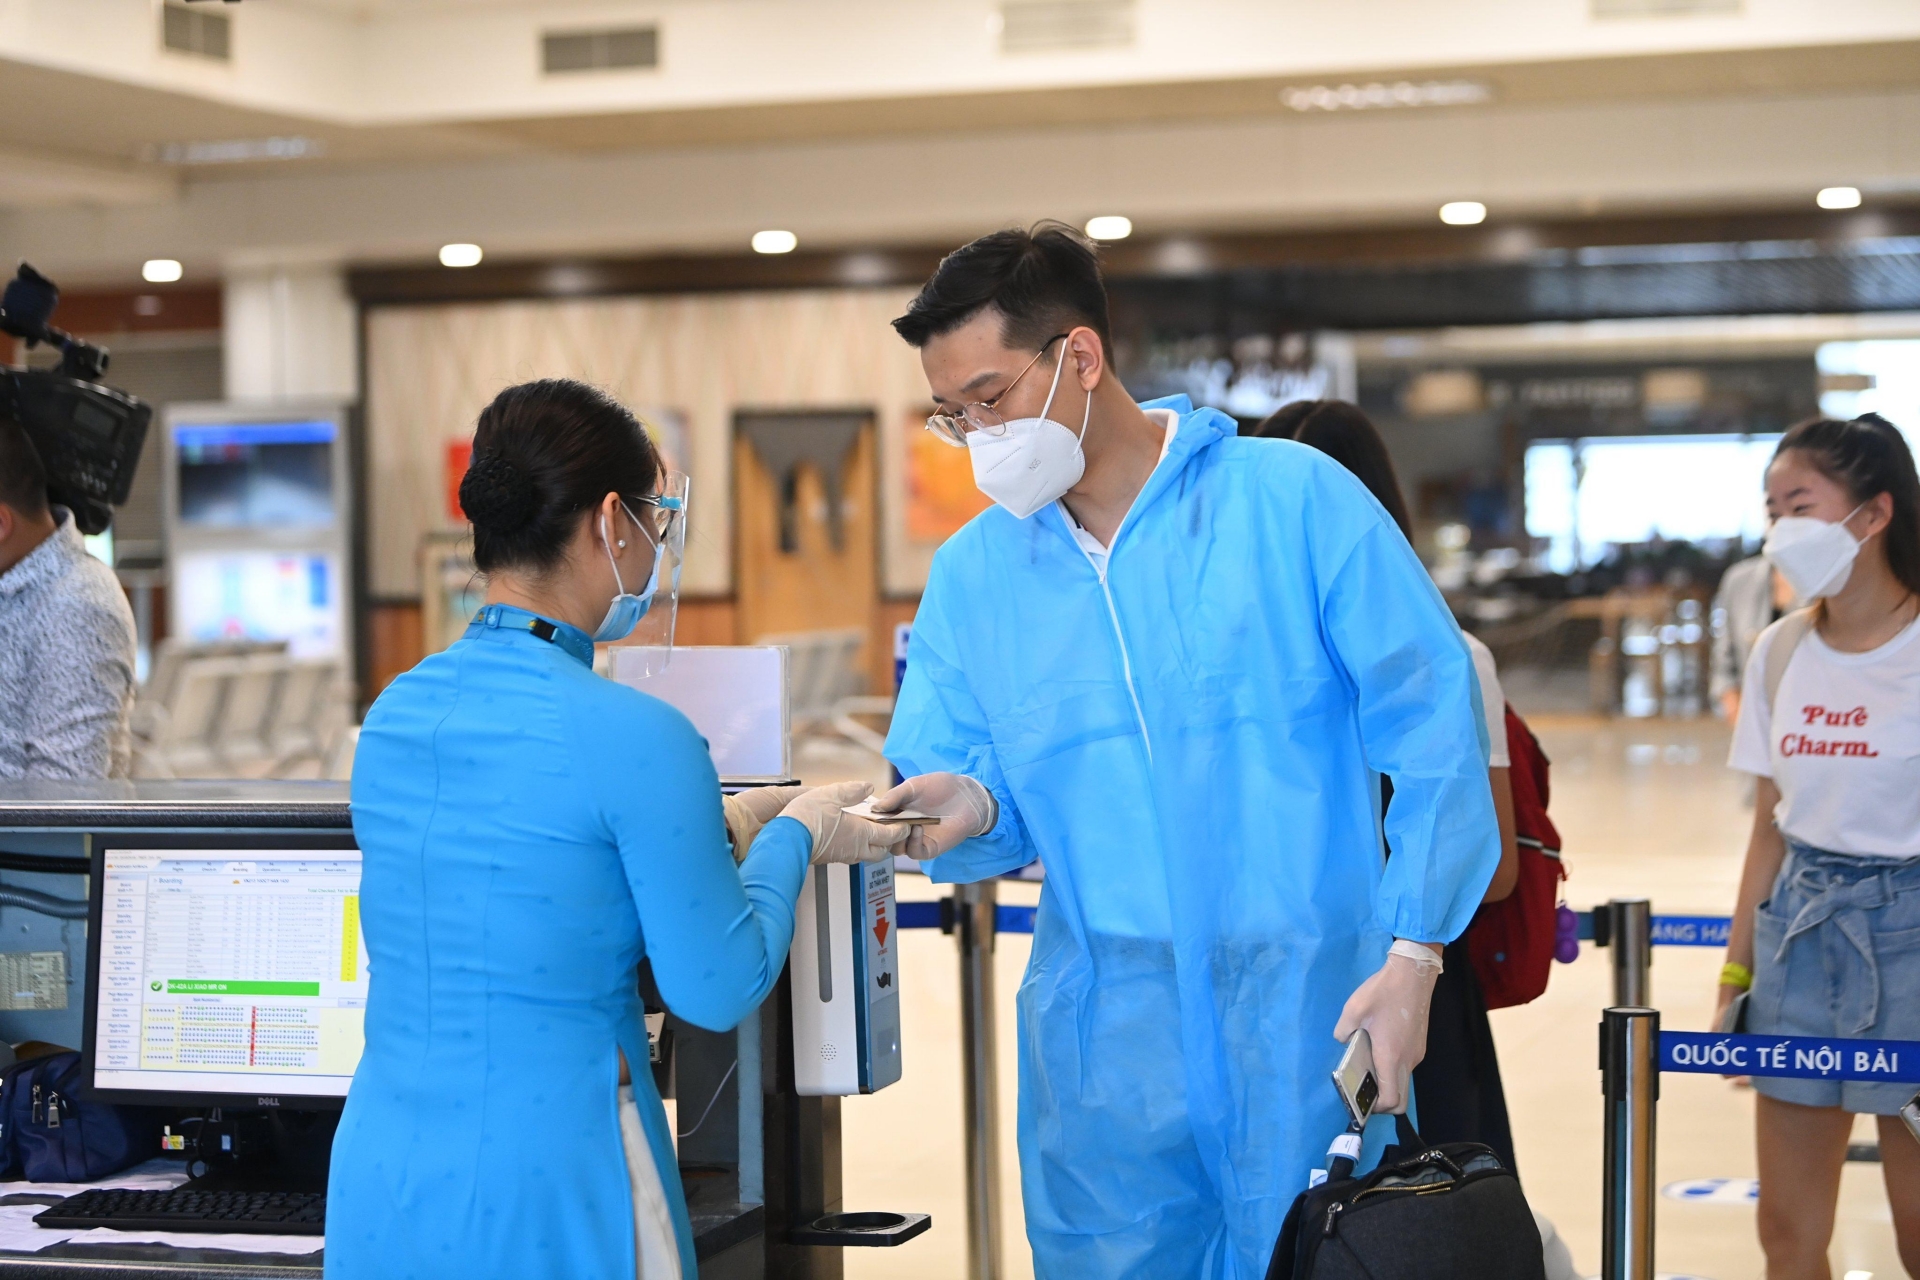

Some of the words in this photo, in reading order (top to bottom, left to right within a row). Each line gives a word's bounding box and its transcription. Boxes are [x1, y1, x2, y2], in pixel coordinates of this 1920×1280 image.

[1803, 704, 1869, 727] Pure
[1671, 1038, 1748, 1067] QUỐC
[1756, 1041, 1791, 1069] TẾ
[1794, 1045, 1842, 1076] NỘI
[1854, 1048, 1898, 1073] BÀI
[258, 1096, 280, 1106] DELL
